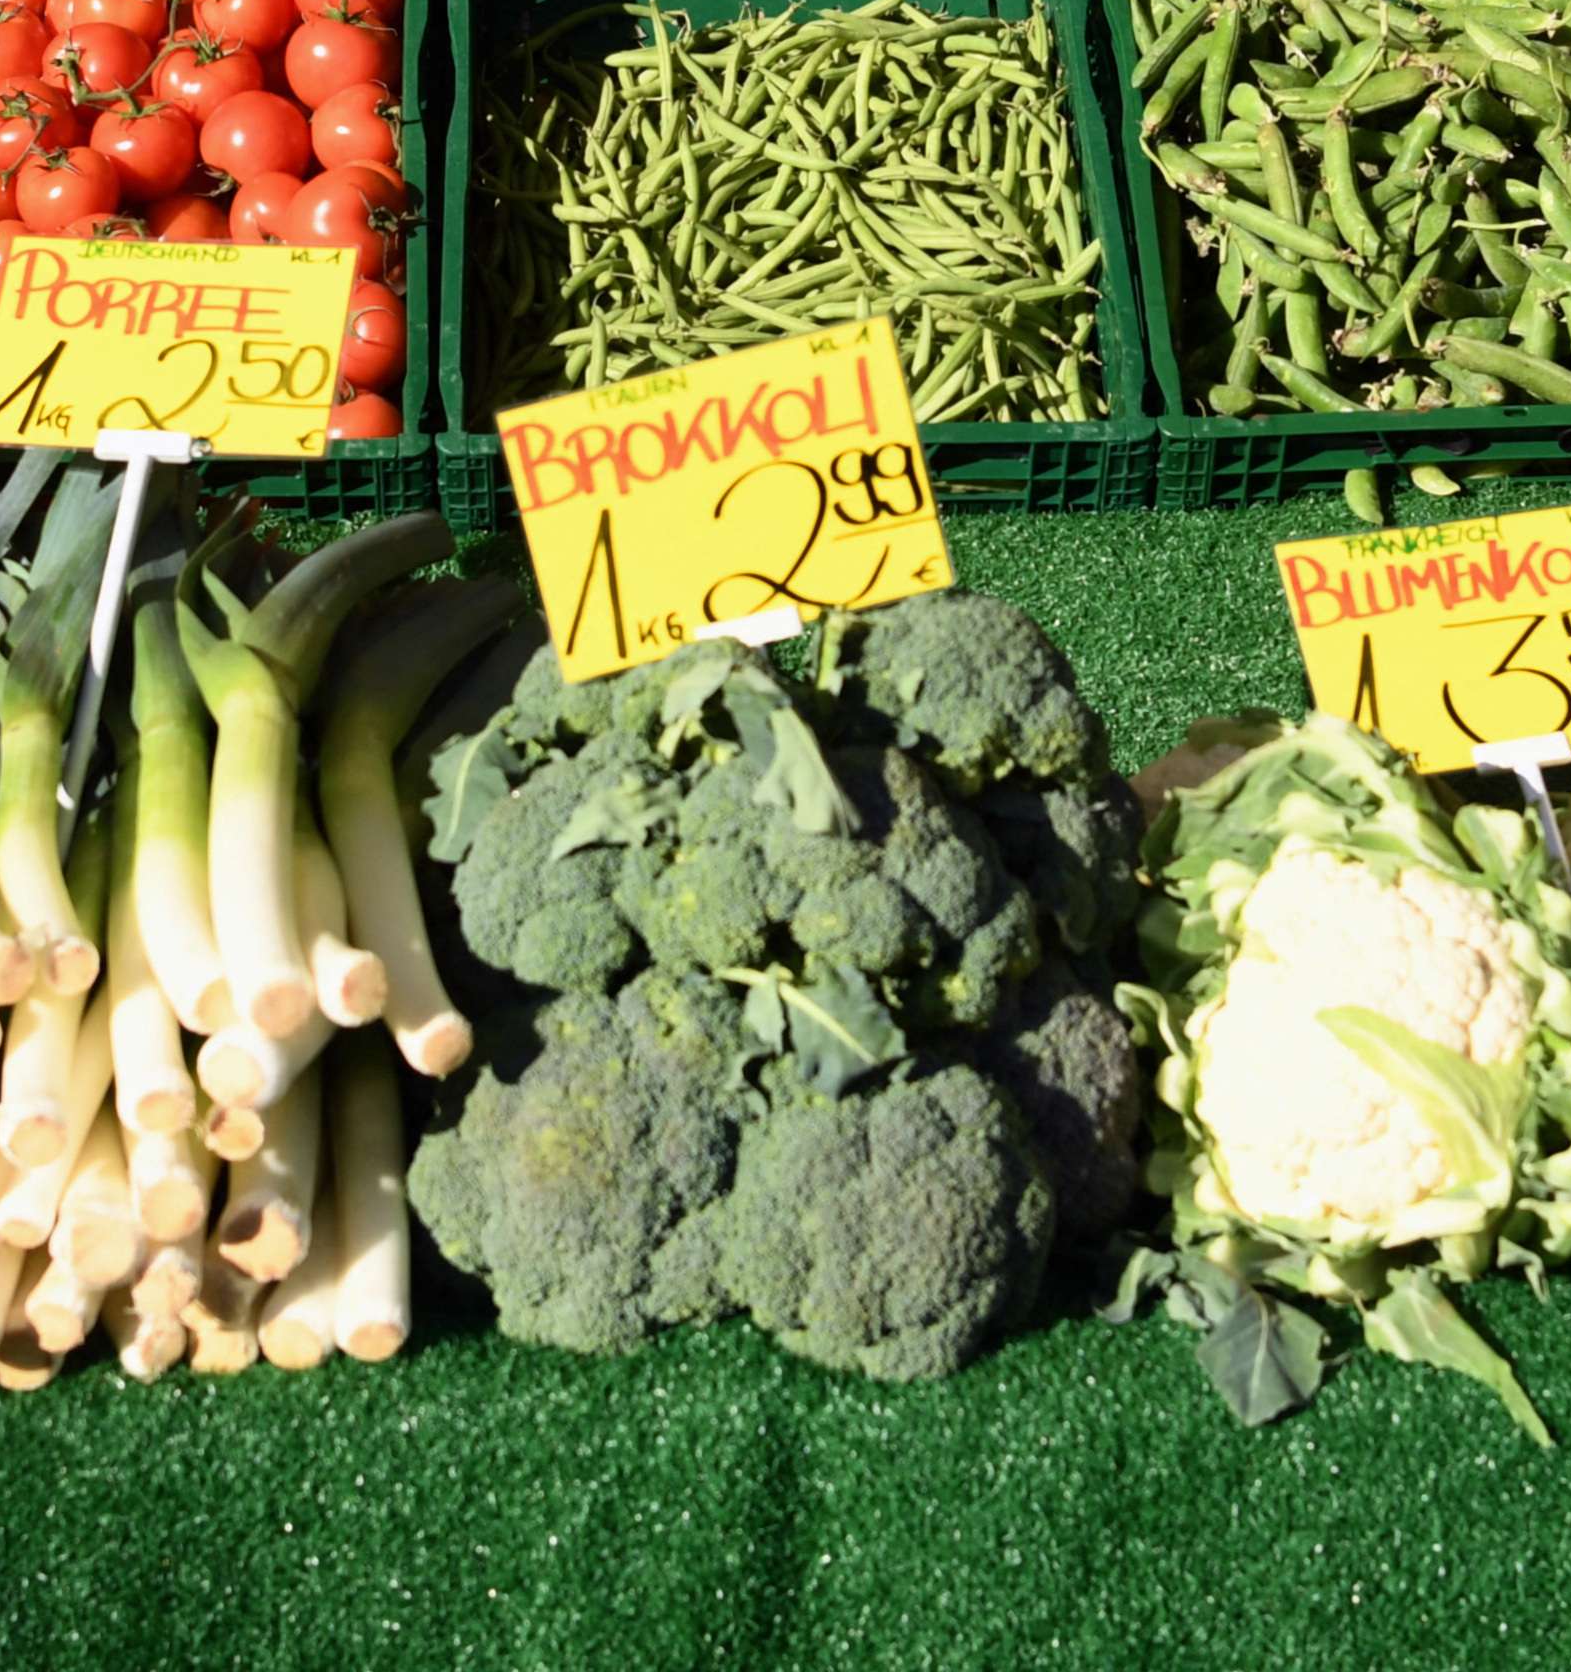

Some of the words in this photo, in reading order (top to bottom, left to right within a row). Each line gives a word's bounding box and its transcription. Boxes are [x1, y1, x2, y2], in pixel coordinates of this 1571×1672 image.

[78, 240, 240, 262] DEUTSCHLAND
[9, 249, 291, 338] PORREE
[589, 371, 688, 410] ITALIEN
[501, 355, 878, 513] BROKKOLI
[1341, 516, 1504, 558] FRANKREICH
